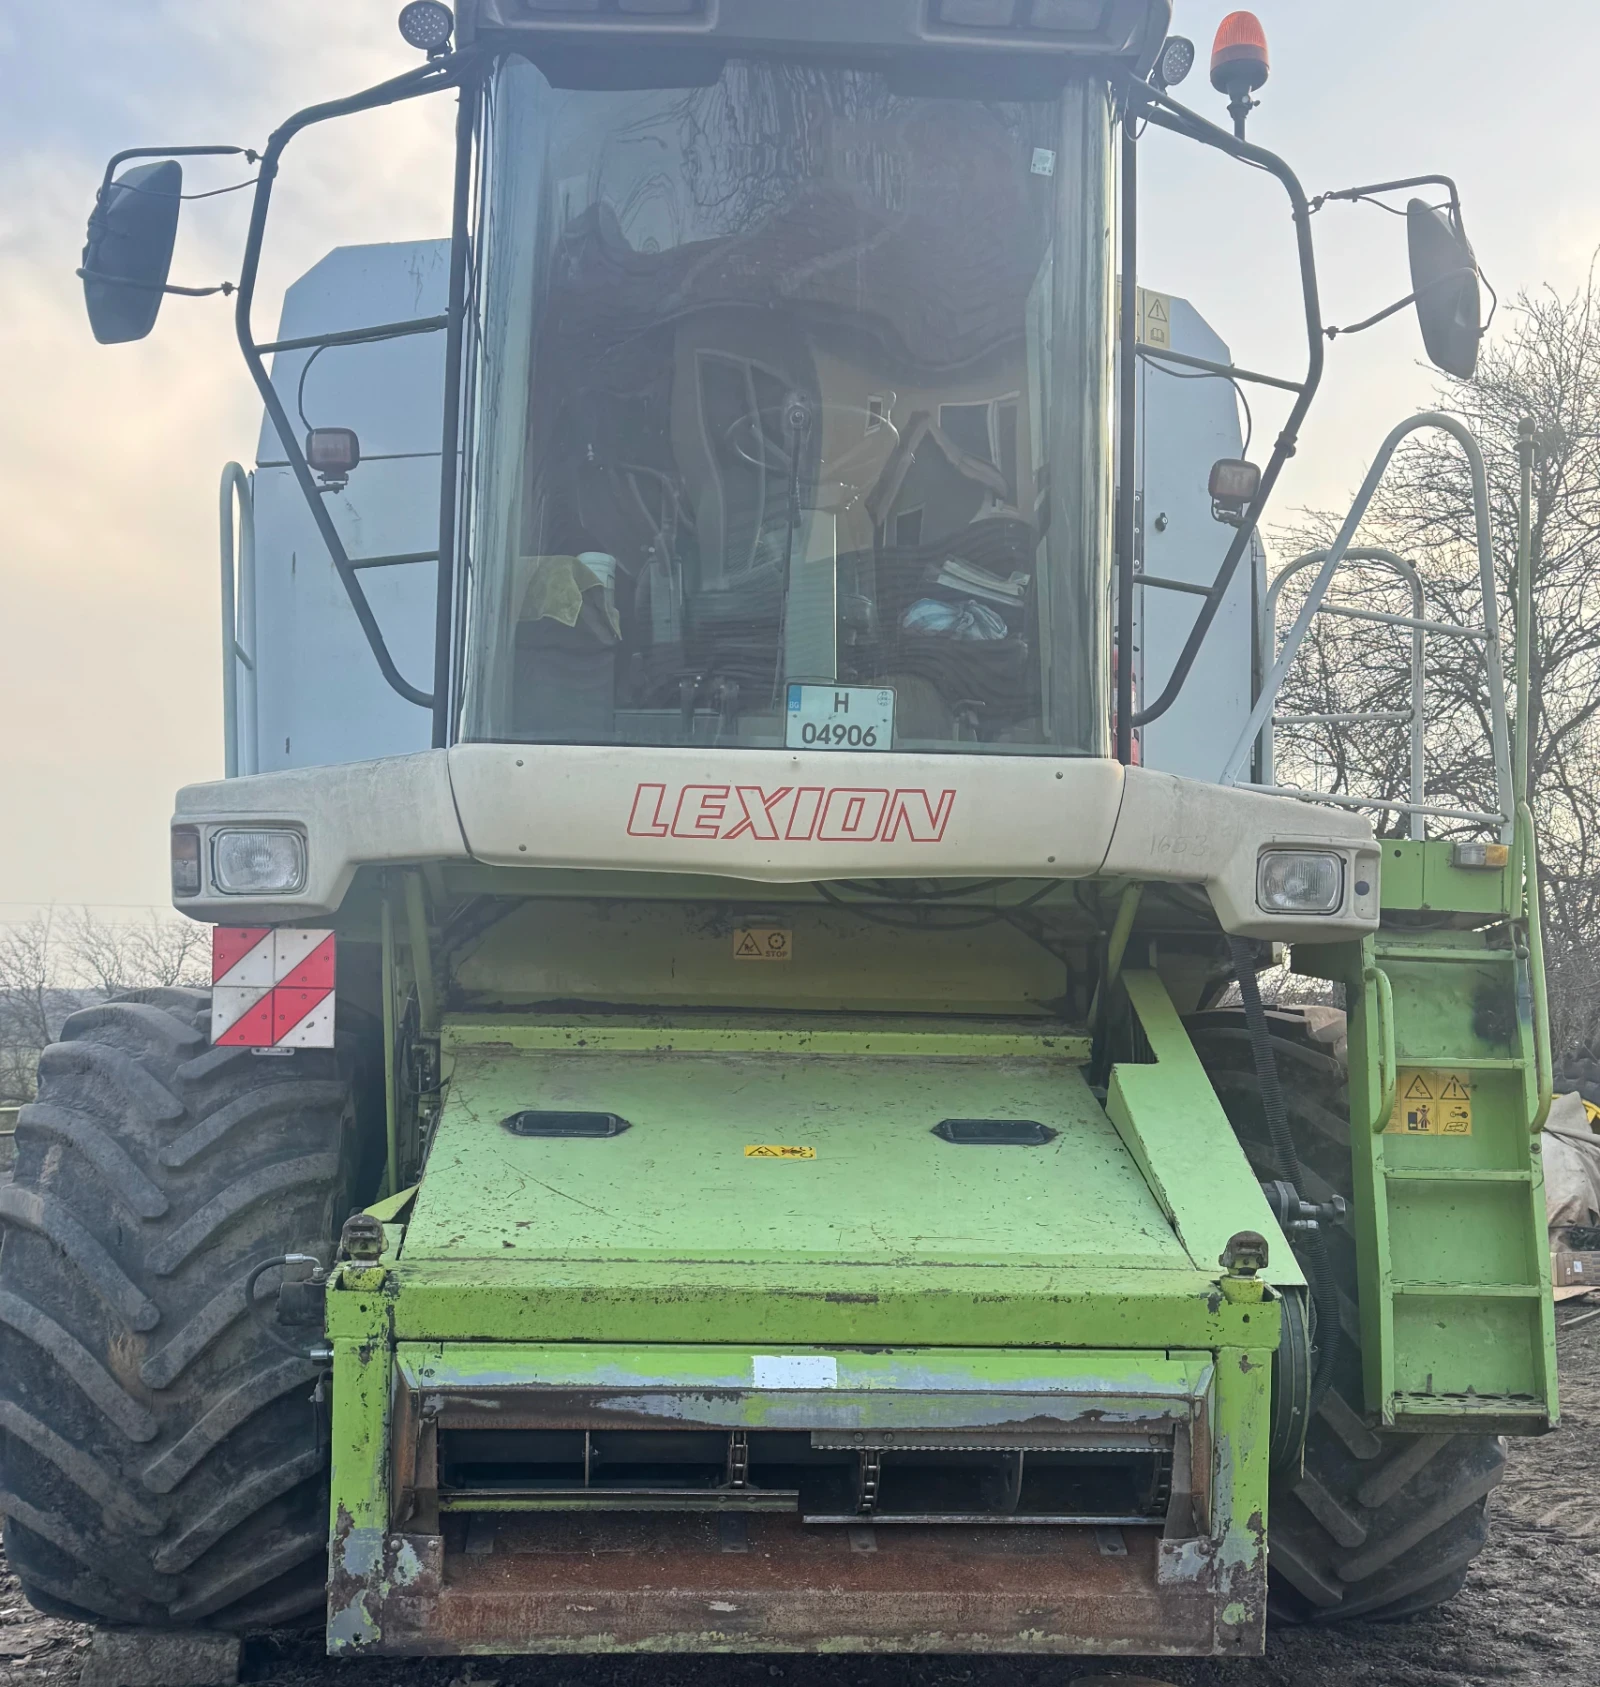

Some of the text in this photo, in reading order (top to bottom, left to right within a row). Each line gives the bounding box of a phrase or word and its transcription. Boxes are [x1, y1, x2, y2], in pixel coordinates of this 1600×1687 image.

[789, 701, 799, 709] BG
[834, 692, 849, 713] H
[801, 722, 877, 747] 04906
[627, 783, 957, 842] LEXION
[765, 950, 788, 958] STOP
